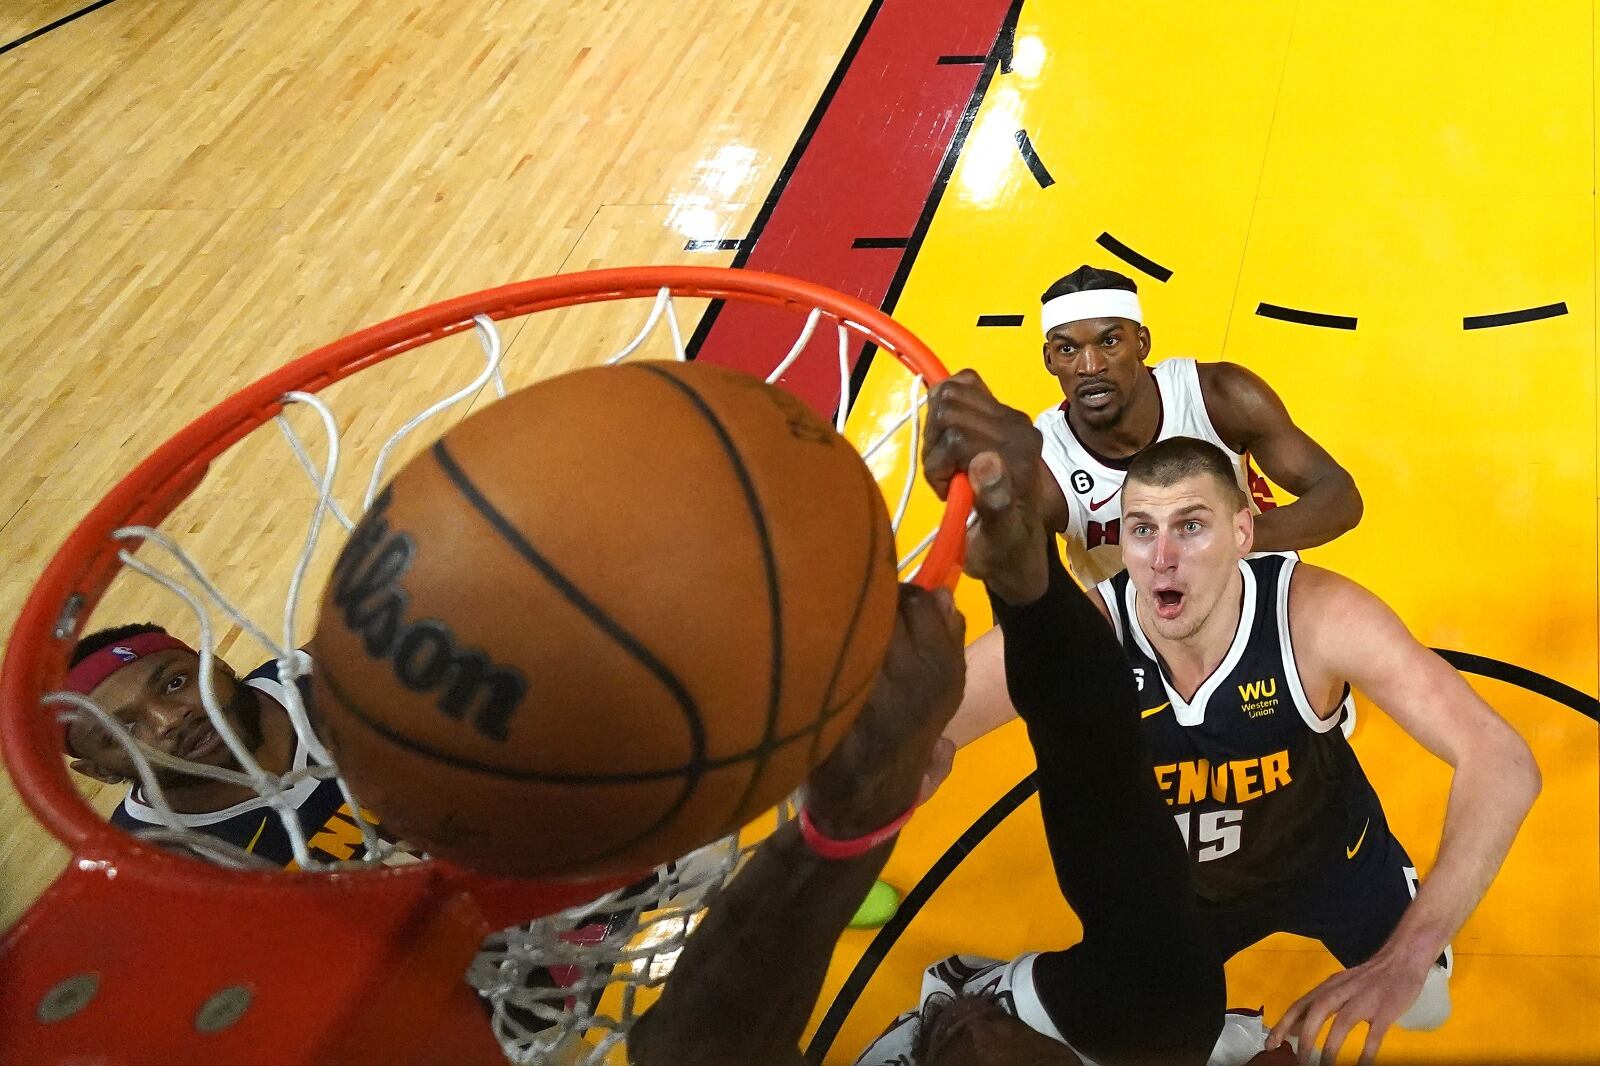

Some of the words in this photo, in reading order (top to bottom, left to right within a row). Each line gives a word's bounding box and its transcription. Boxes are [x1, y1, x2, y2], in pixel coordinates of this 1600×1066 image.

[1237, 677, 1276, 702] WU
[1240, 698, 1279, 712] Western
[1248, 707, 1275, 719] Union
[1153, 749, 1293, 806] ENVER
